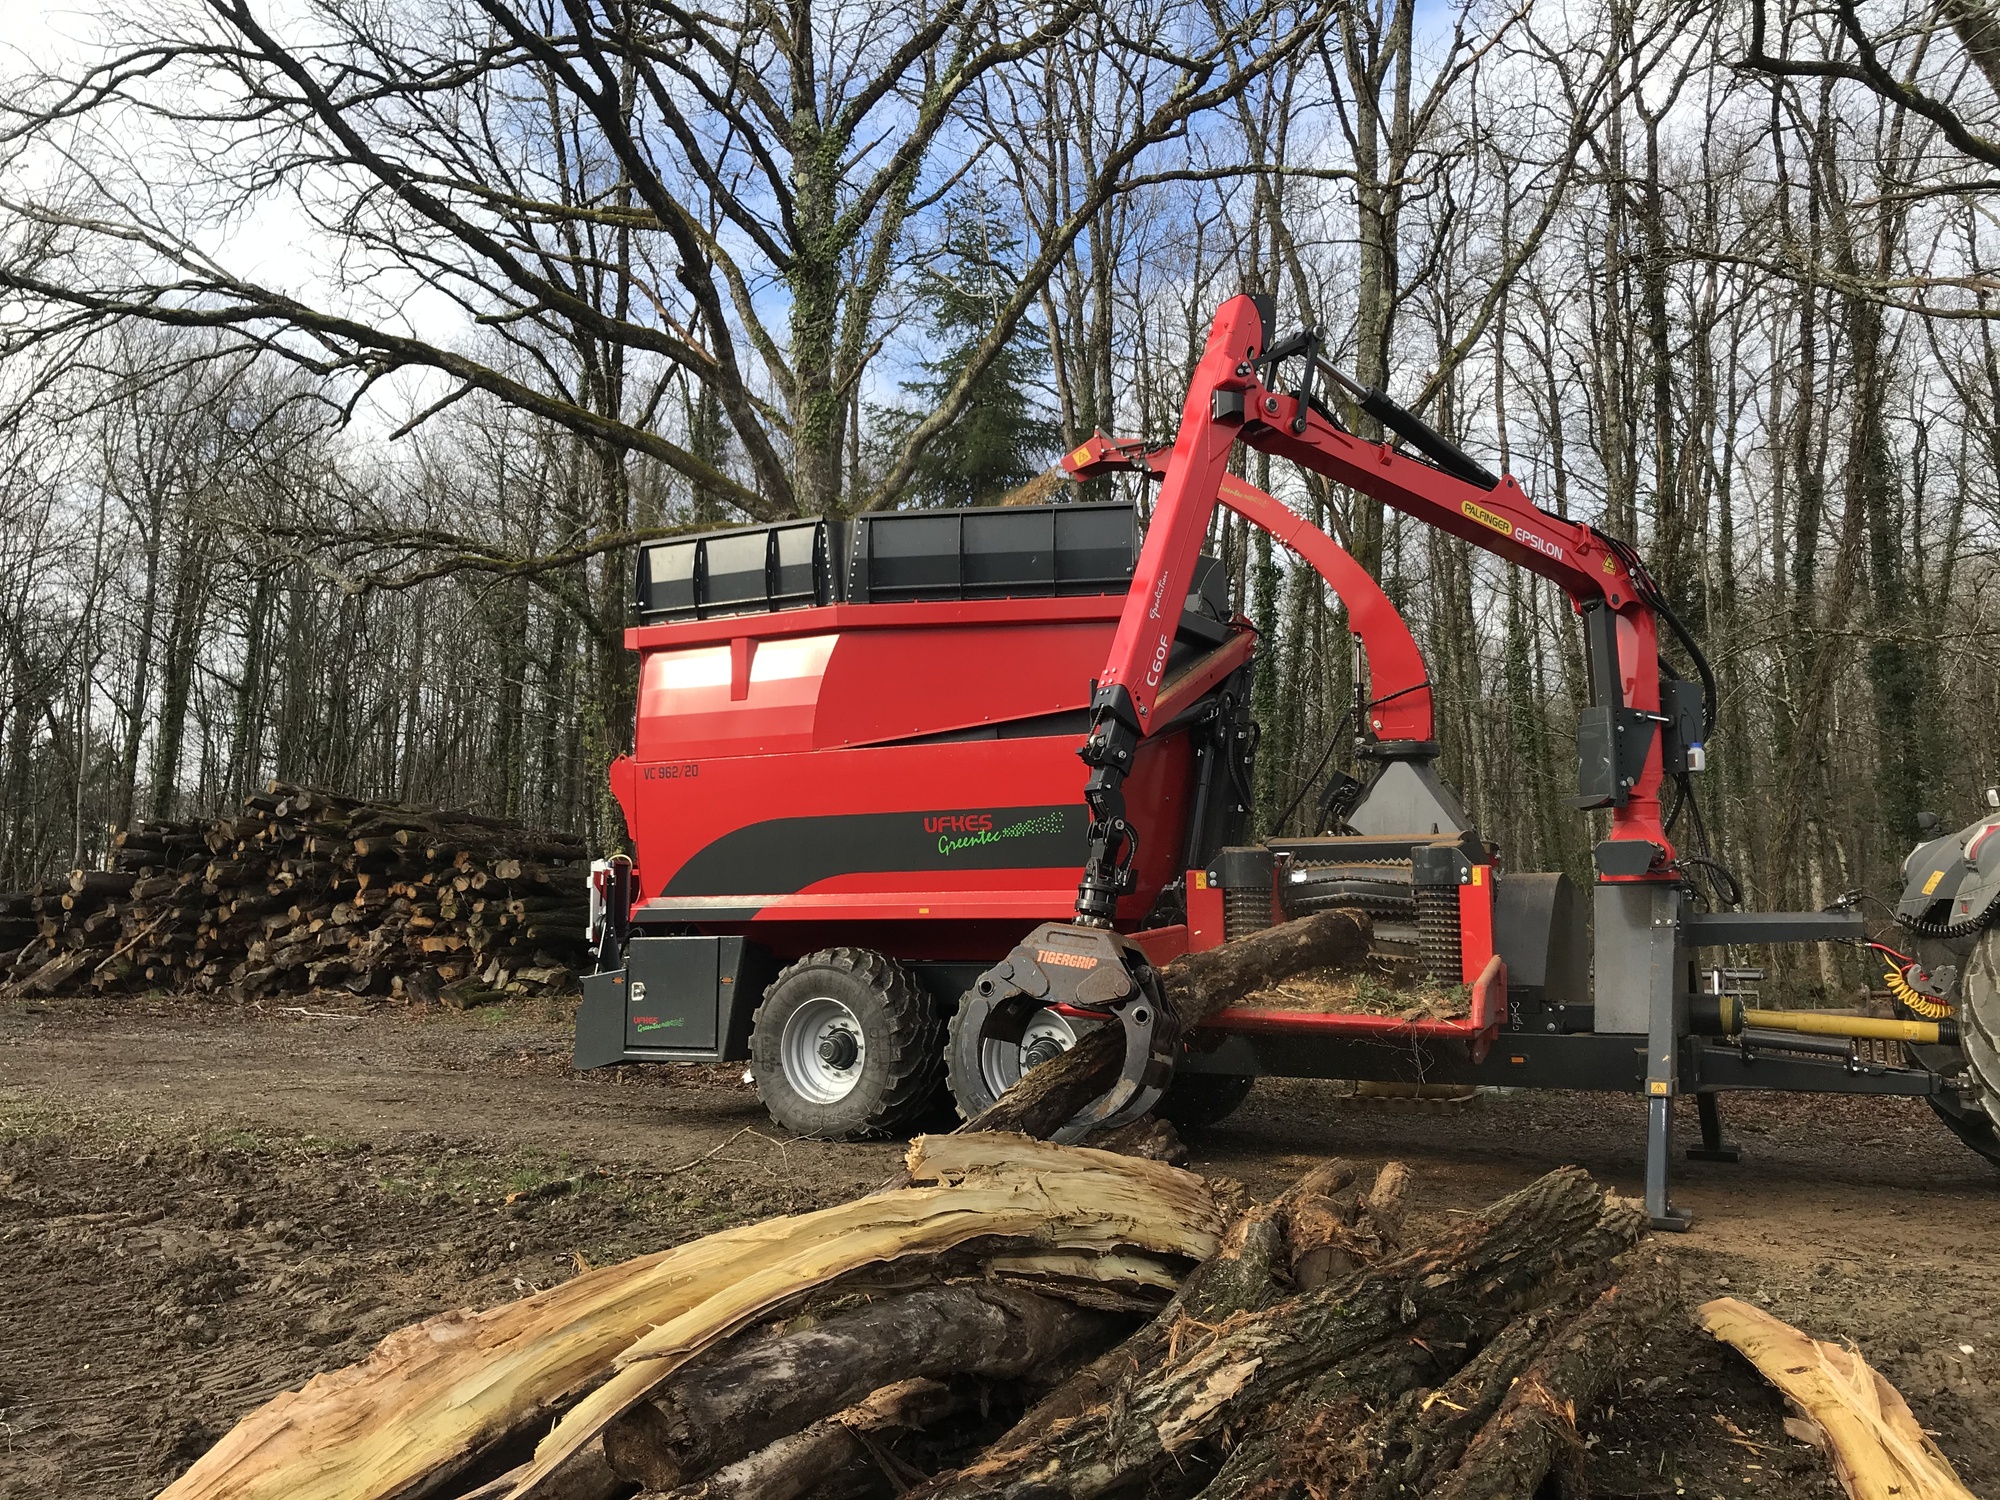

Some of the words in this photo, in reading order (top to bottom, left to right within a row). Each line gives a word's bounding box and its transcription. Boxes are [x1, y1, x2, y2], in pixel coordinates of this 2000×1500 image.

[1464, 503, 1510, 532] PALFINGER
[1515, 528, 1563, 560] EPSILON
[1147, 634, 1168, 687] C60F
[643, 767, 656, 780] VC
[658, 764, 699, 779] 962/20
[923, 813, 993, 833] UFKES
[938, 828, 1002, 857] Greentec
[1037, 950, 1098, 970] TIGERGRIP
